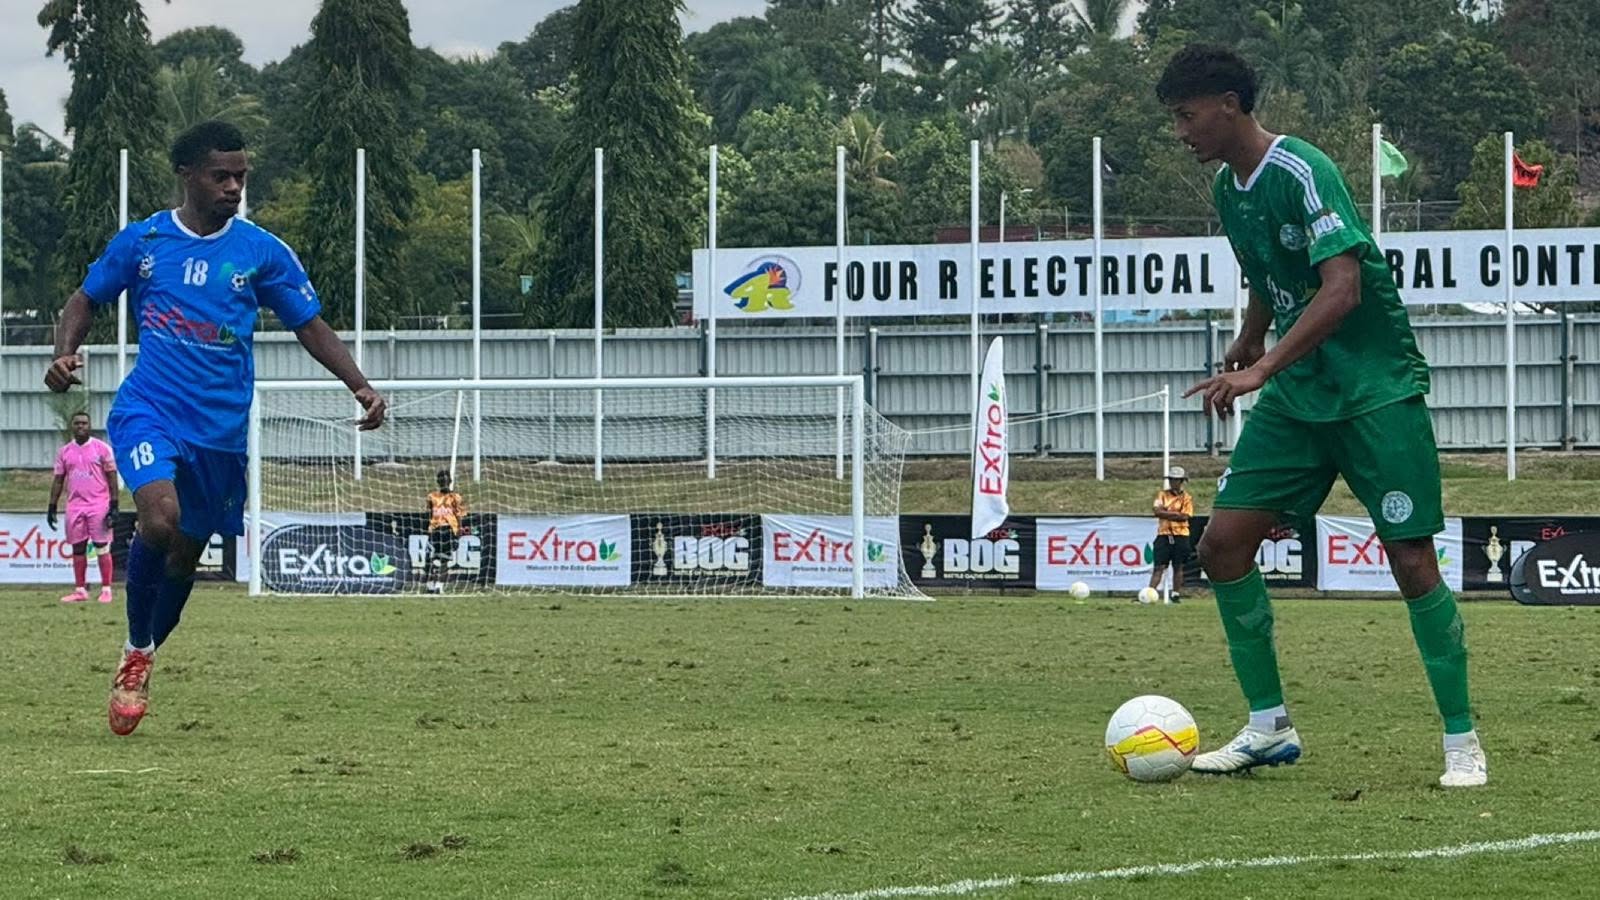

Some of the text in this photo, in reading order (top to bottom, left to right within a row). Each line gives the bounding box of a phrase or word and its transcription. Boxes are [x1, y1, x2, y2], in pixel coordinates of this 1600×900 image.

[181, 257, 209, 286] 18
[824, 261, 917, 301] FOUR
[939, 261, 957, 299] R
[980, 253, 1214, 299] ELECTRICAL
[1479, 245, 1600, 287] CONT
[129, 441, 155, 471] 18
[278, 543, 371, 575] Extra
[408, 534, 481, 568] BG
[508, 526, 597, 562] Extra
[674, 536, 749, 570] BOG
[943, 538, 1020, 573] BOG
[1047, 530, 1141, 566] Extra
[1254, 538, 1303, 573] OG
[1328, 532, 1385, 565] Ext
[1536, 554, 1600, 588] Extr
